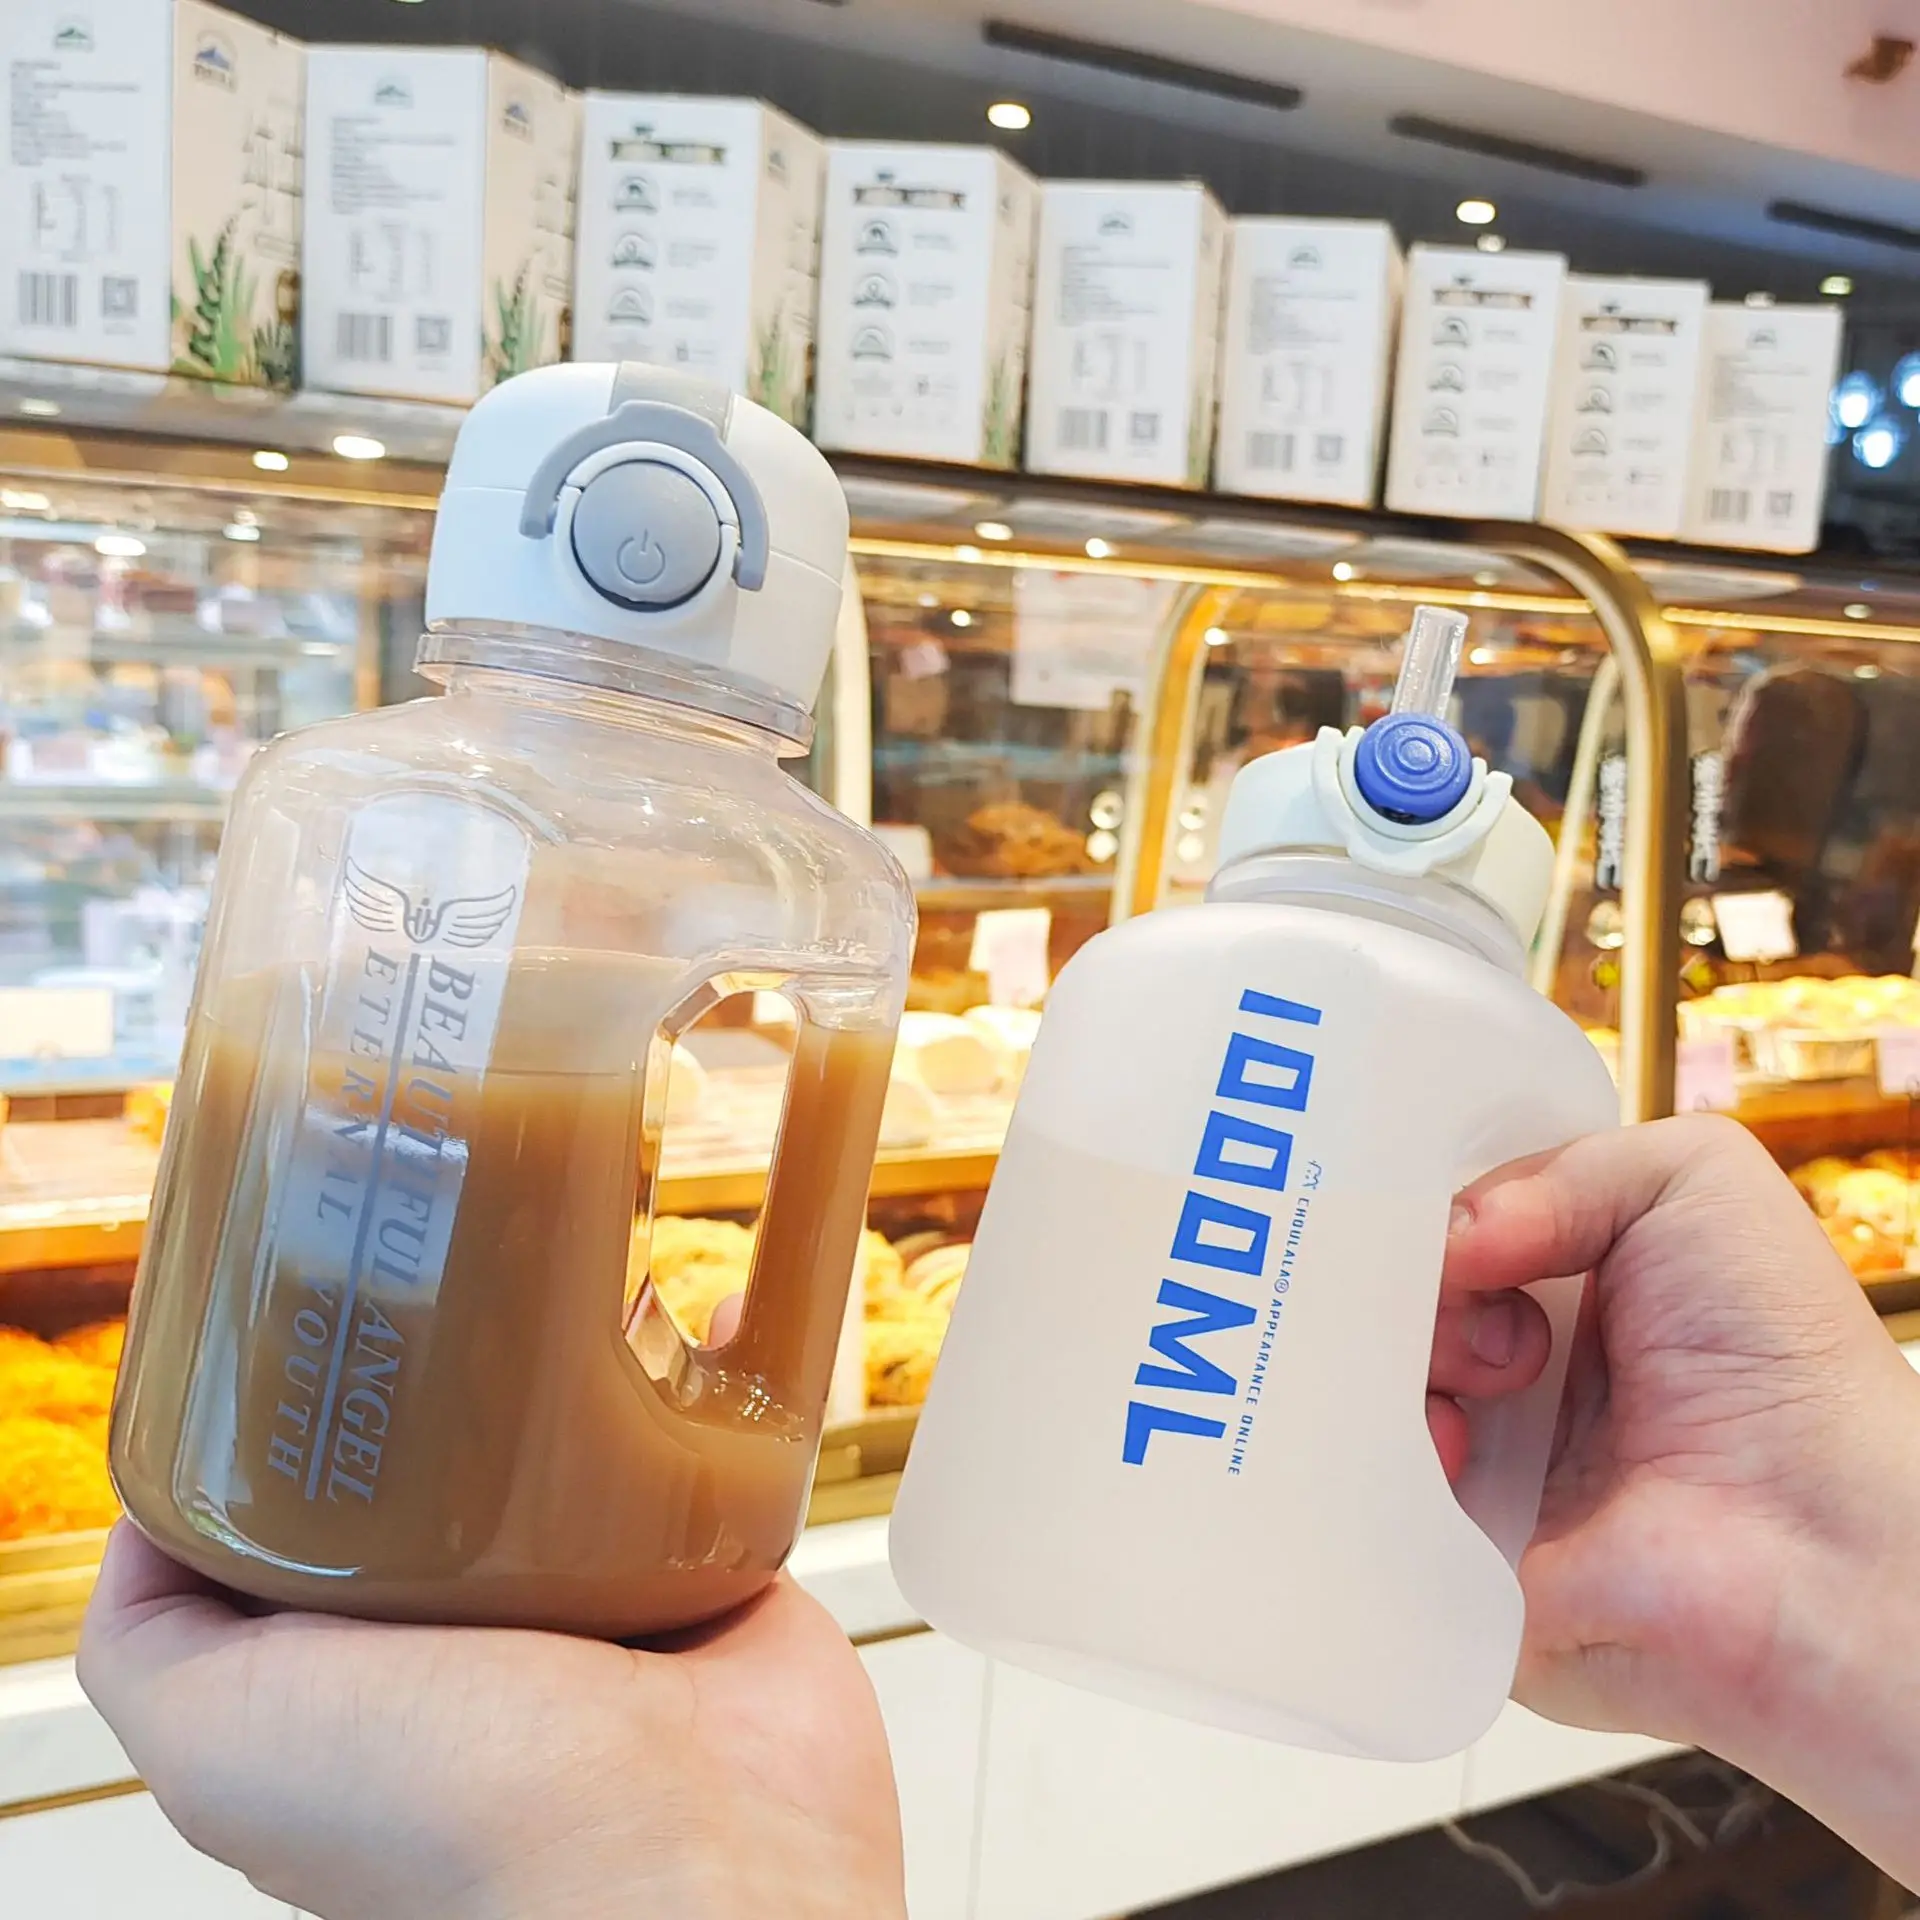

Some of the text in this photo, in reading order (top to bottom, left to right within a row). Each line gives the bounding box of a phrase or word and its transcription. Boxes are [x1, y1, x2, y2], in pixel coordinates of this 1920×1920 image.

[326, 955, 476, 1503] BEAUTIFUL ANGEL
[1122, 988, 1321, 1466] 1000ML
[267, 1276, 341, 1483] YOUTH
[1228, 1414, 1254, 1475] ONLINE
[1246, 1298, 1283, 1406] APPEARANCE
